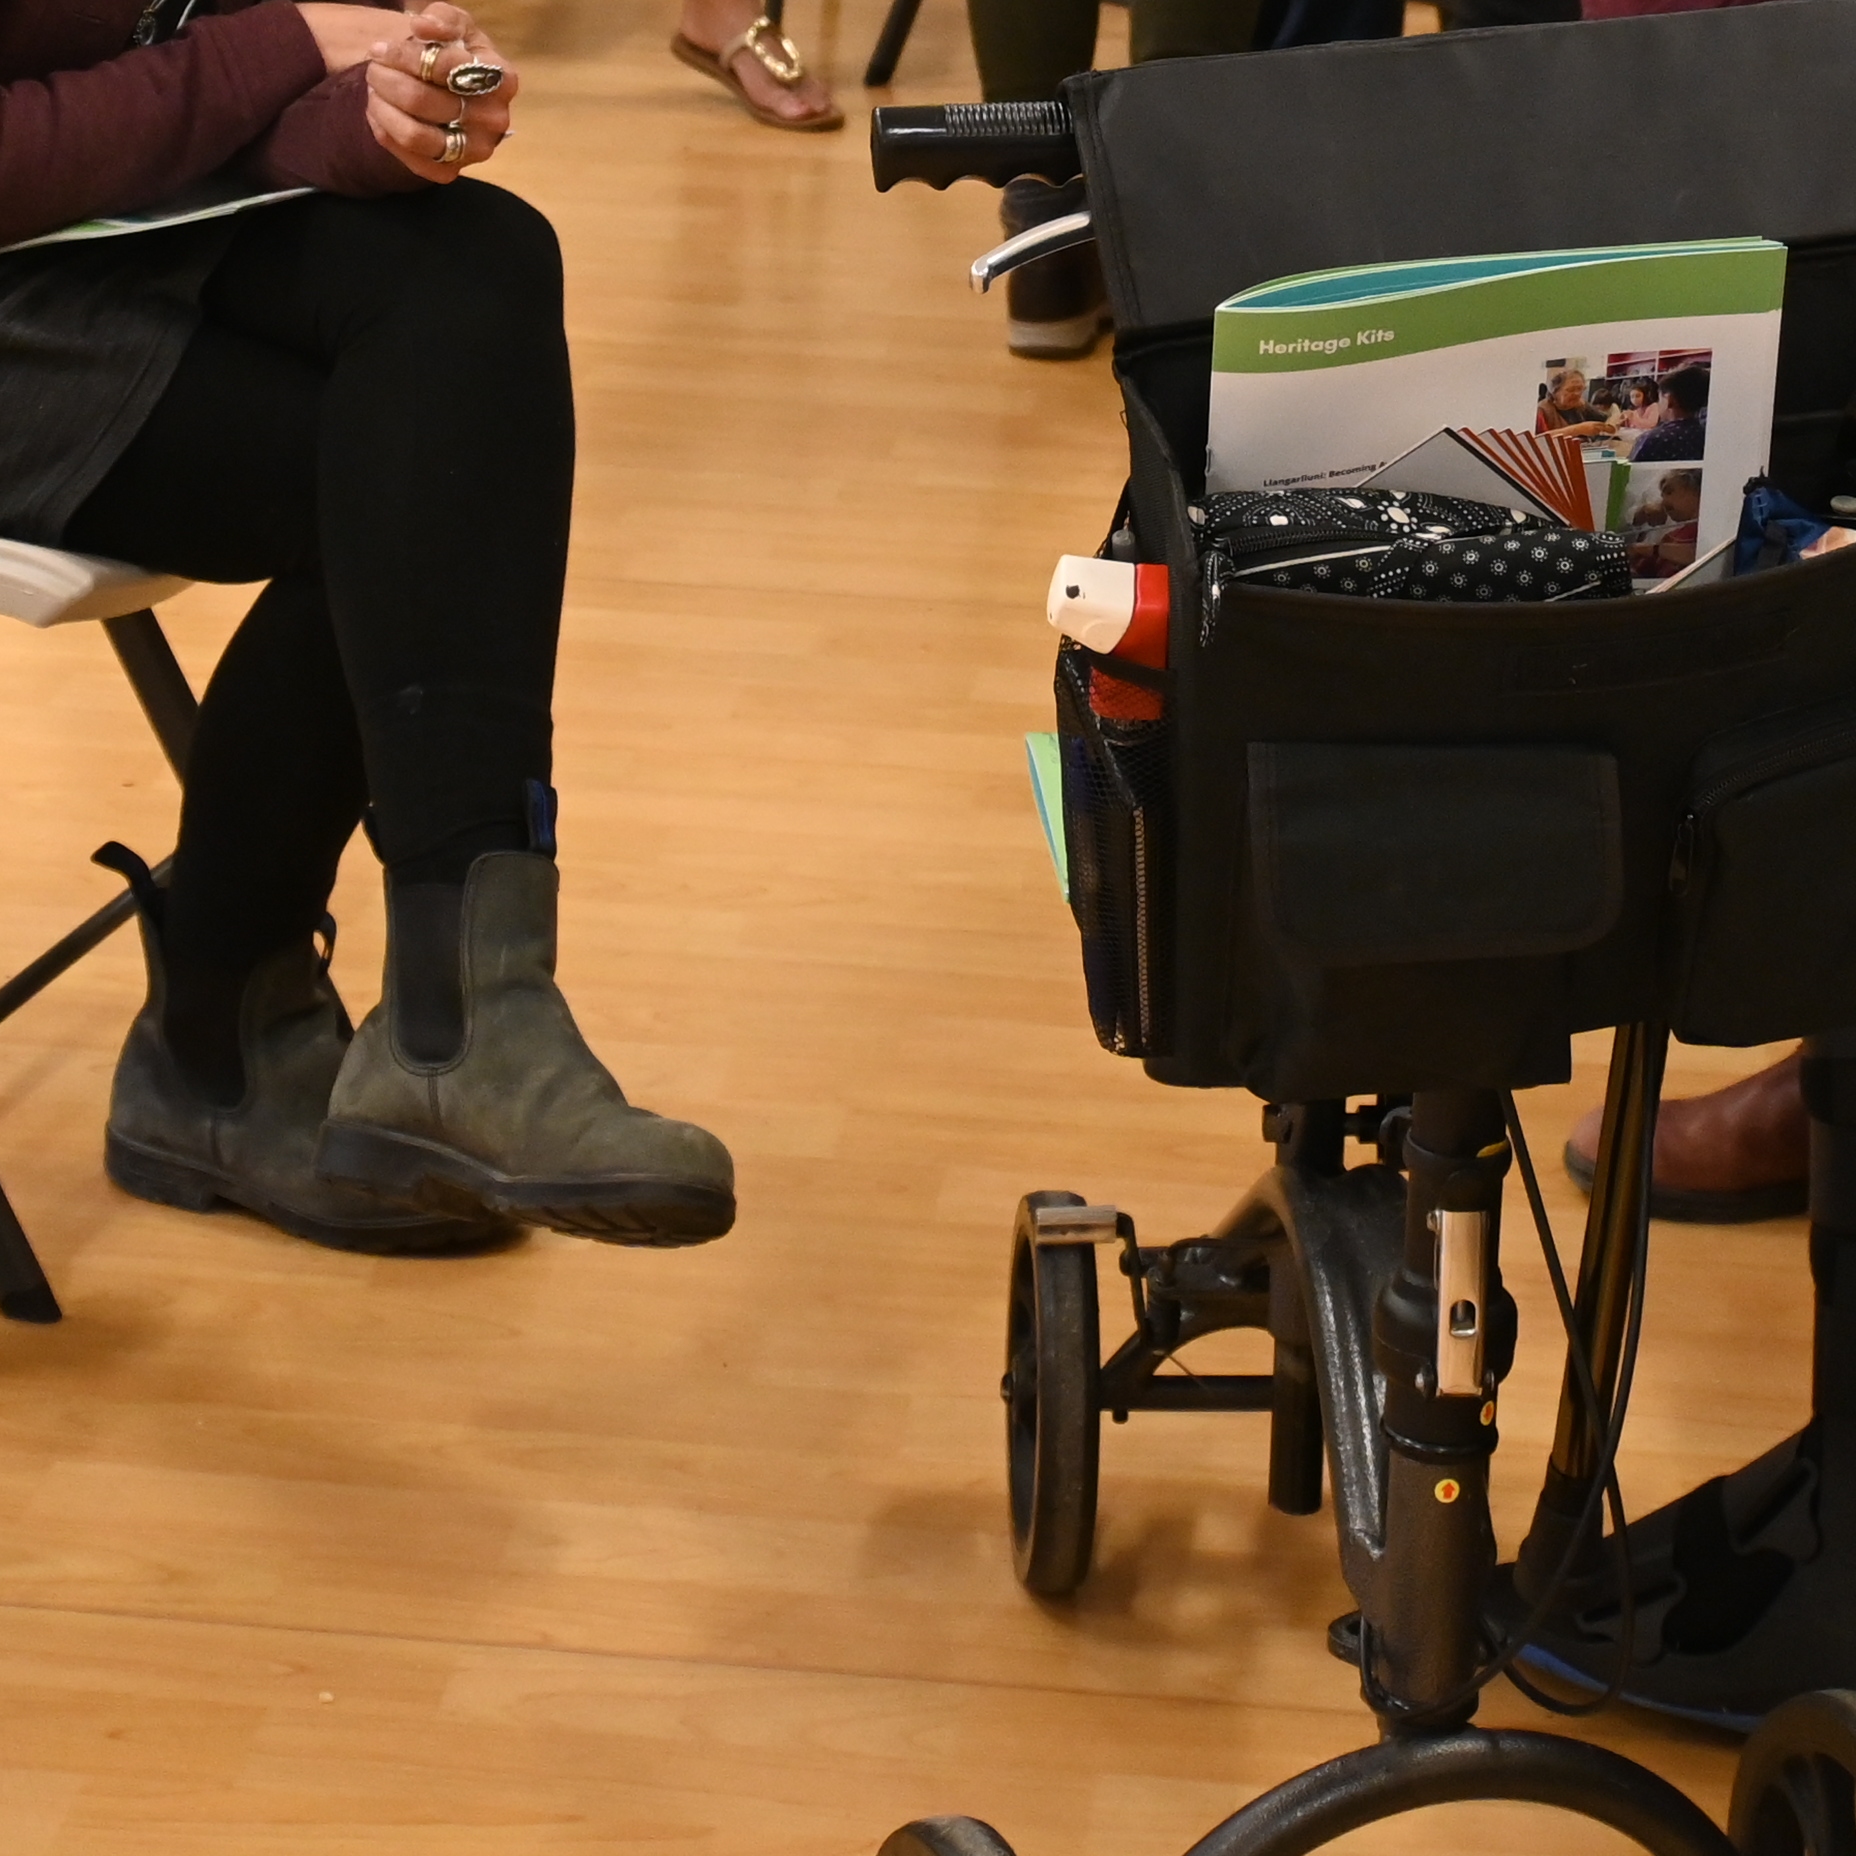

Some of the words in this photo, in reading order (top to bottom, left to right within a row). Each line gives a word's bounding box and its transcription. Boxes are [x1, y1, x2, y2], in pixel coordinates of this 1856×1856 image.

[1258, 336, 1352, 356] Heritage
[1356, 329, 1395, 346] Kits
[1328, 463, 1377, 478] Becoming
